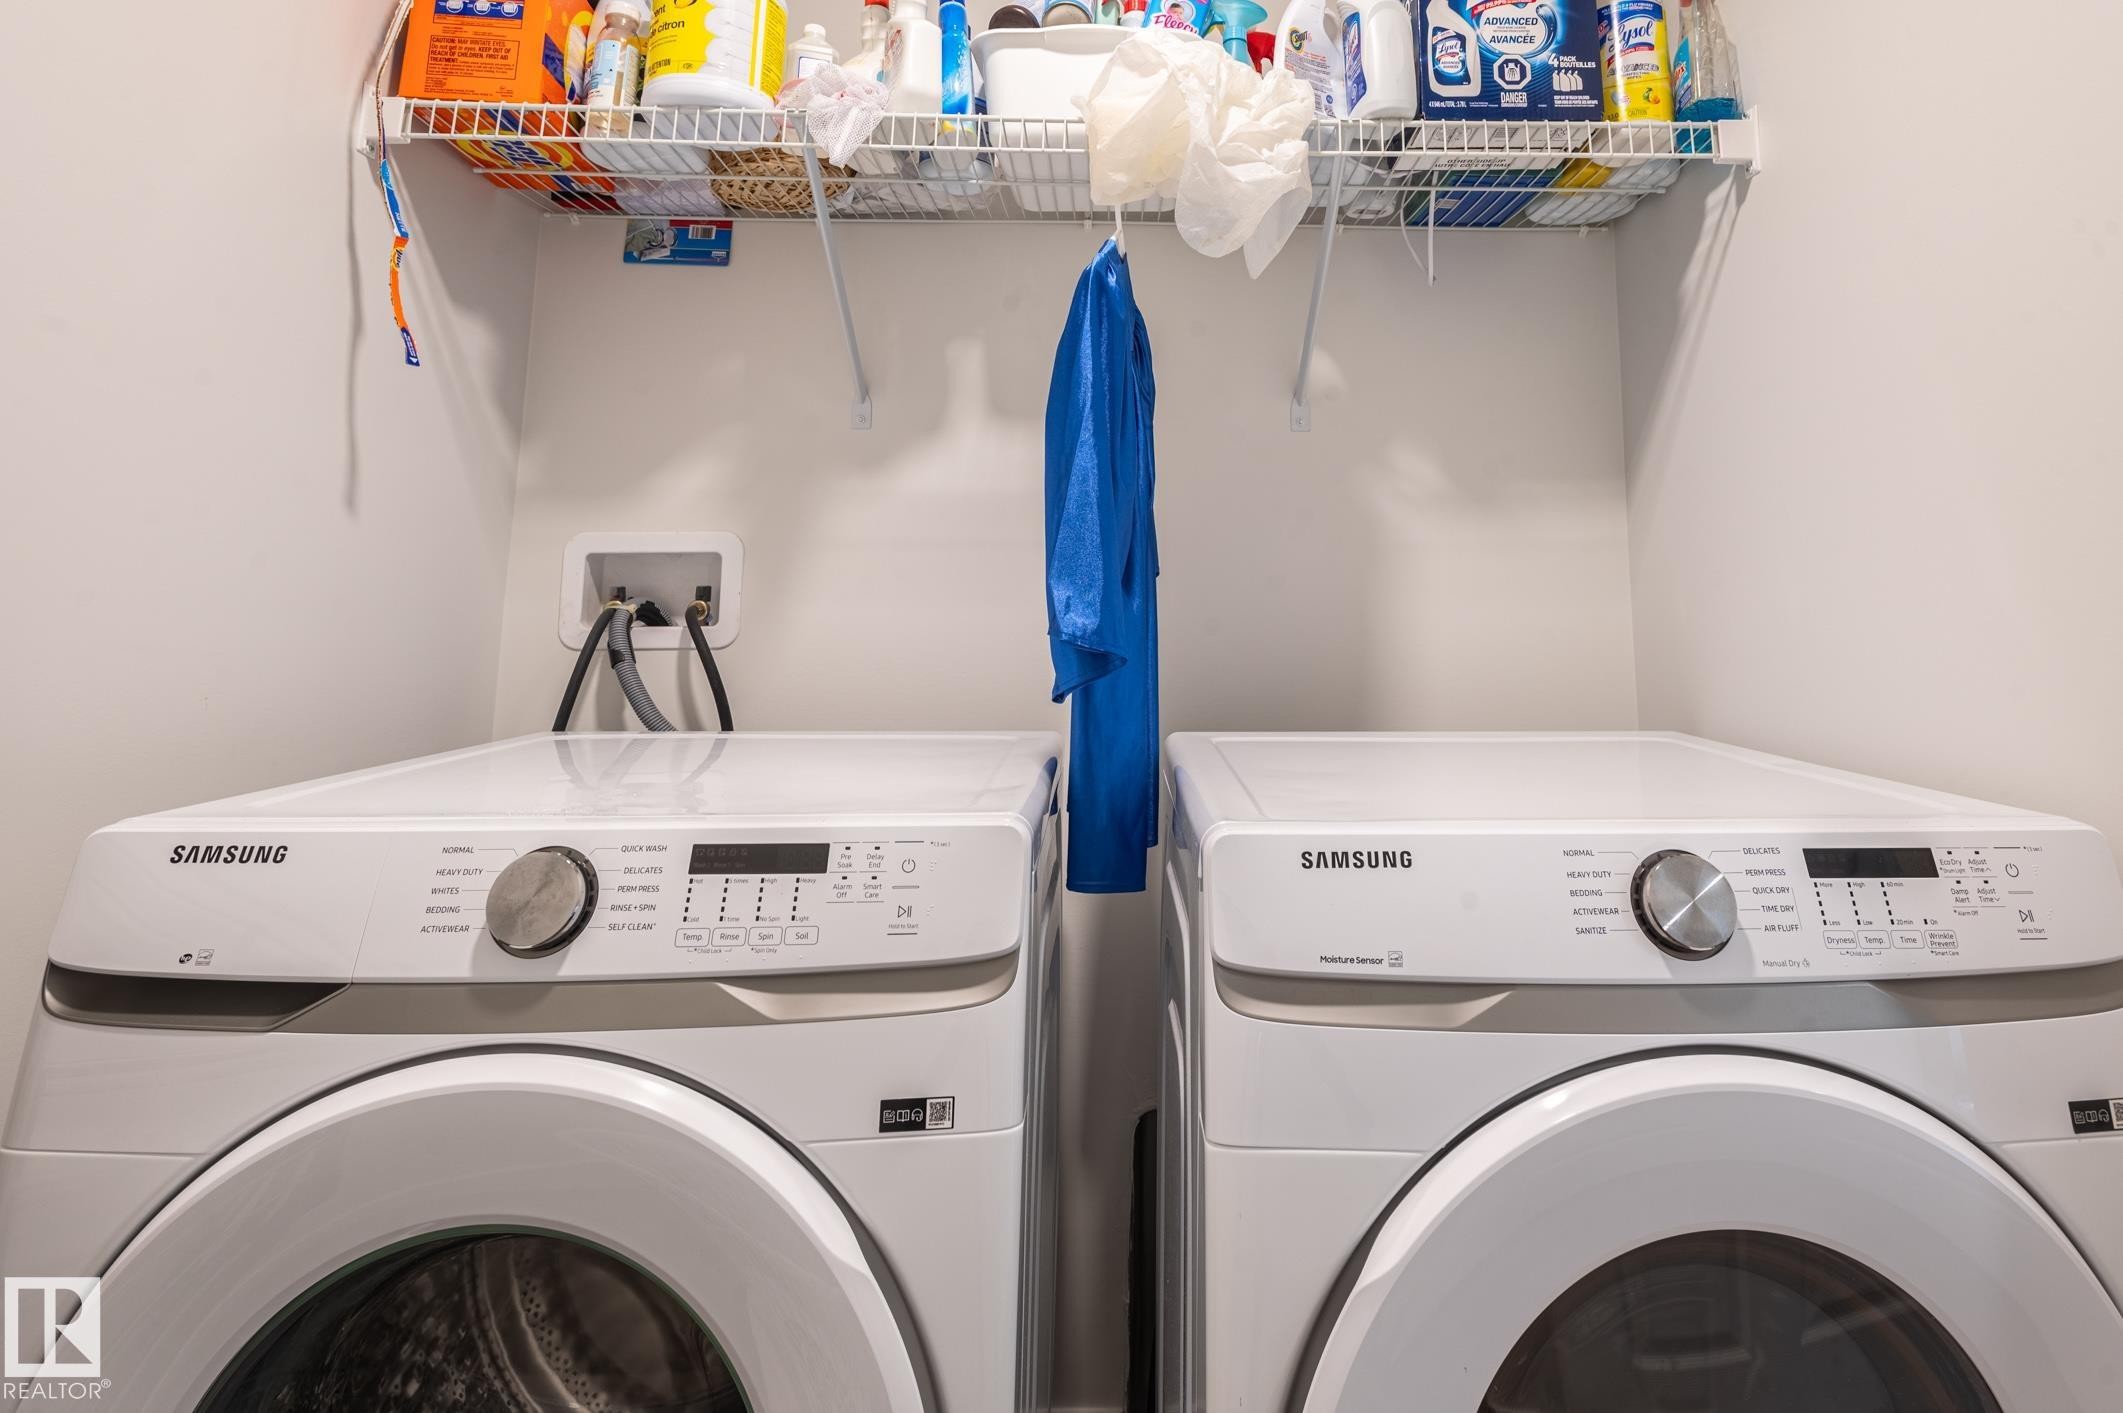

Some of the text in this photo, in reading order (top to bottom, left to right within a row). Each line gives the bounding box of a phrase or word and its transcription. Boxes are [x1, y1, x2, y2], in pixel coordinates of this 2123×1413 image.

[1484, 17, 1539, 26] ADVANCED
[658, 20, 685, 33] citron
[432, 36, 457, 44] CAUTION:
[1489, 33, 1536, 44] AVANCÉE
[430, 49, 449, 57] REACH
[448, 45, 458, 53] get
[1548, 53, 1559, 68] 4
[1500, 92, 1527, 103] DANGER
[442, 846, 475, 854] NORMAL
[621, 845, 644, 853] QUICK
[1563, 849, 1595, 857] NORMAL
[170, 845, 288, 864] SAMSUNG
[867, 853, 884, 861] Delay
[1301, 851, 1413, 869] SAMSUNG
[1951, 859, 1962, 867] Dry
[436, 868, 483, 876] HEAVY DUTY
[1567, 871, 1590, 879] HEAVY
[431, 887, 460, 895] WHITES
[617, 885, 660, 893] PERM PRESS
[1569, 889, 1603, 897] BEDDING
[1951, 888, 1969, 896] Damp
[1977, 888, 1996, 896] Adjust
[425, 906, 460, 914] BEDDING
[610, 904, 633, 912] RINSE
[420, 925, 470, 933] ACTIVEWEAR
[608, 923, 627, 931] SELF
[1576, 927, 1607, 935] SANITIZE
[683, 933, 702, 942] Temp
[758, 932, 774, 942] Spin
[795, 932, 809, 940] Soil
[1900, 936, 1918, 944] Time
[1826, 937, 1856, 945] Dryness
[1320, 955, 1355, 964] Moisture
[1356, 956, 1384, 965] Sensor
[1789, 960, 1800, 968] Dry
